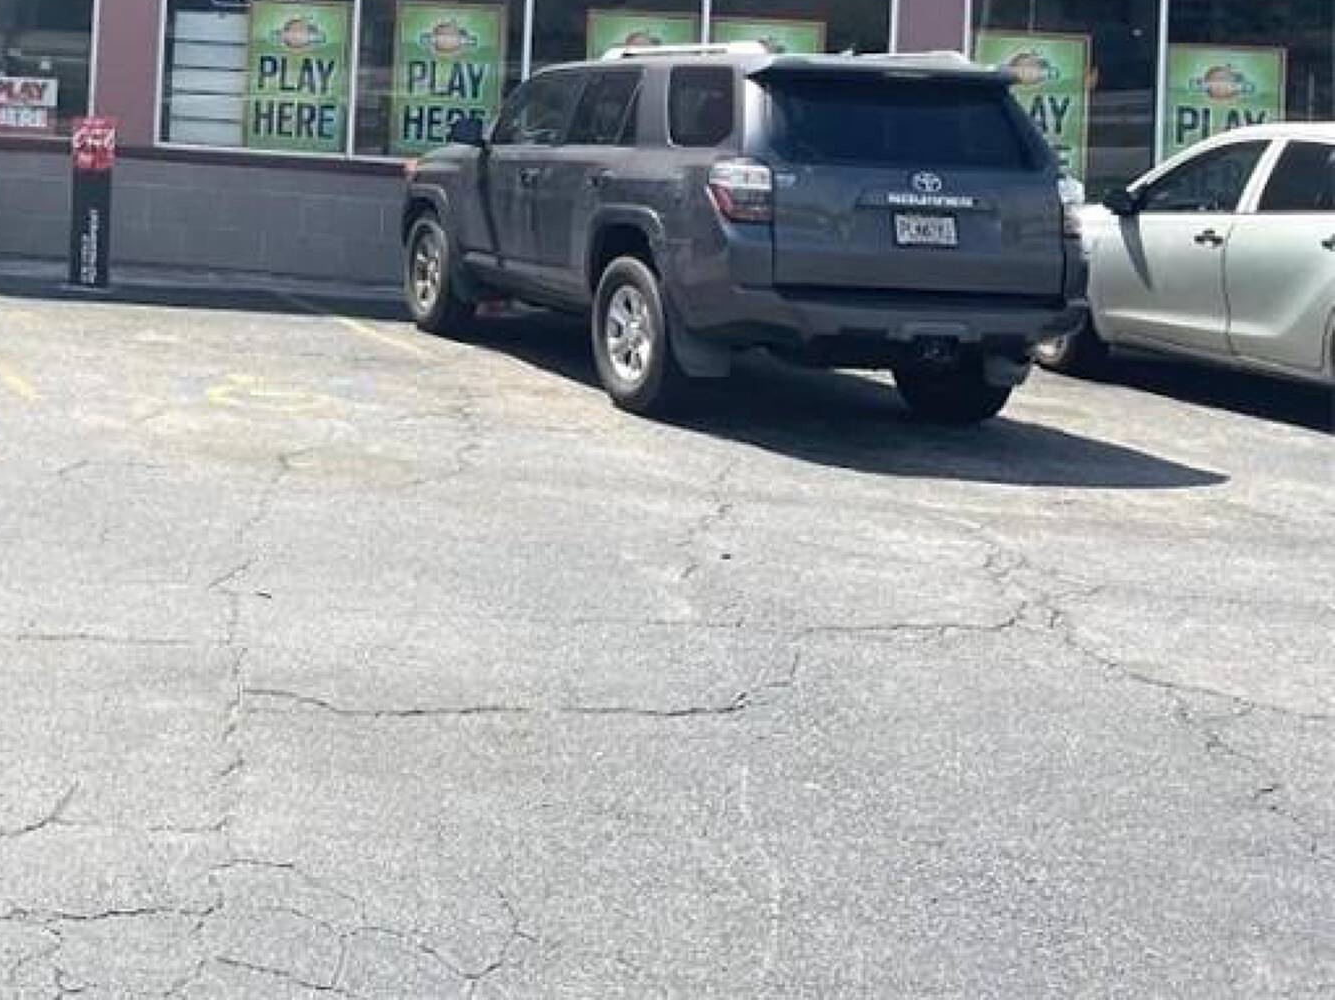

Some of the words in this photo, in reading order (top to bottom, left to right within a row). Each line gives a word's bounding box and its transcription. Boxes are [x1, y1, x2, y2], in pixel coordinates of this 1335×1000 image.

[257, 55, 335, 96] PLAY
[408, 61, 483, 99] PLAY
[253, 99, 336, 139] HERE
